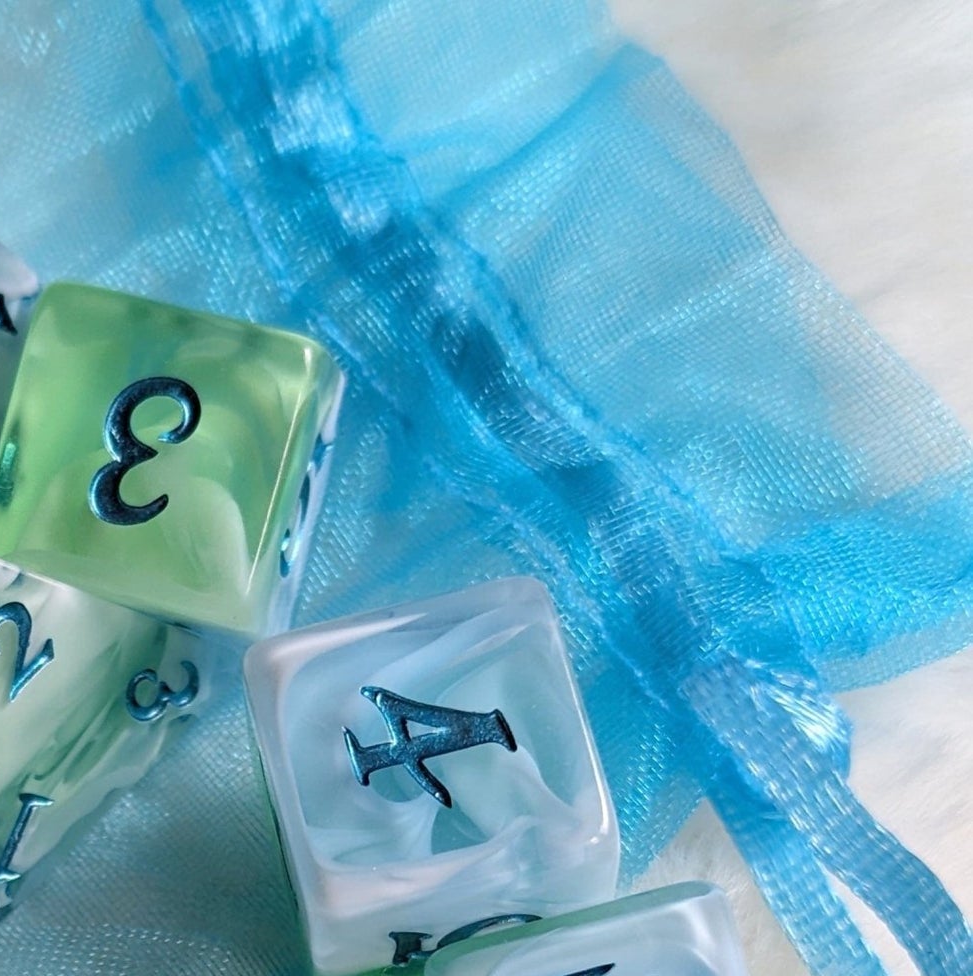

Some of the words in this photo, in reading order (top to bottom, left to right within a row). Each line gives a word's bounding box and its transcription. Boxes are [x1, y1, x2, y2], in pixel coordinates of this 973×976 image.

[87, 376, 201, 526] 3
[126, 660, 200, 722] 3
[341, 685, 518, 810] 4
